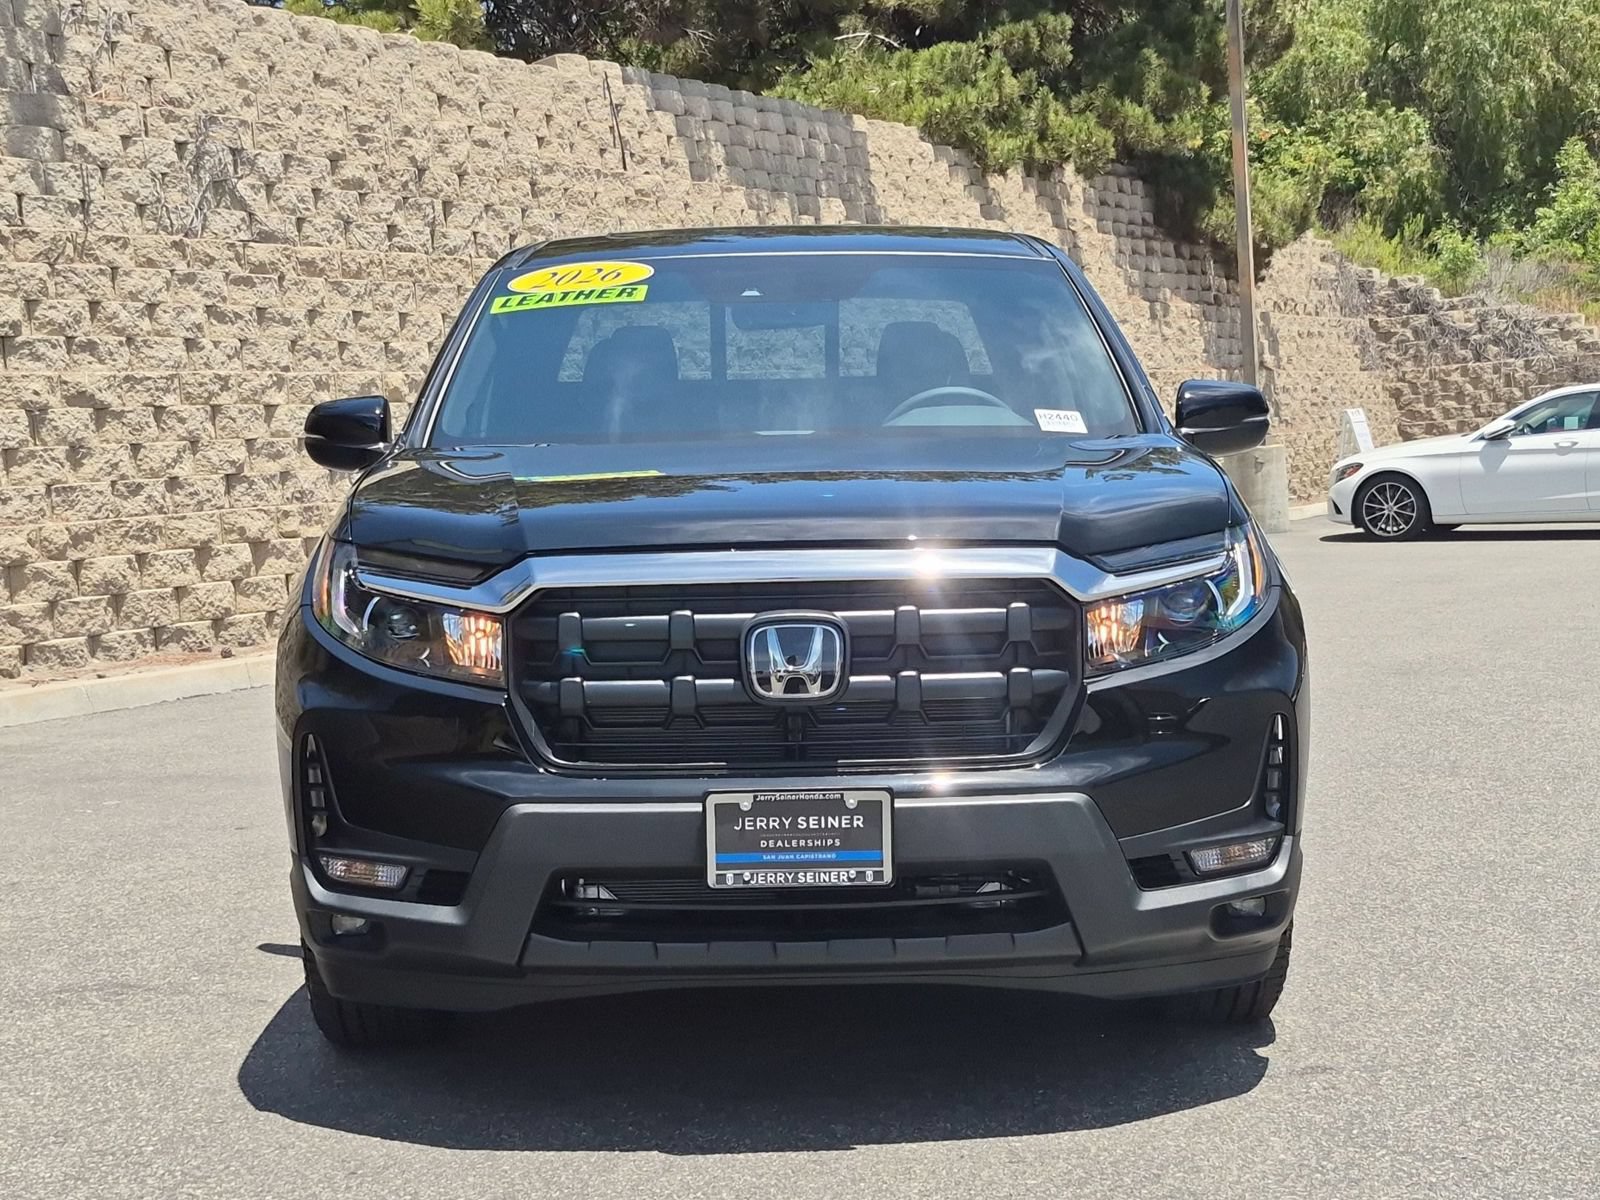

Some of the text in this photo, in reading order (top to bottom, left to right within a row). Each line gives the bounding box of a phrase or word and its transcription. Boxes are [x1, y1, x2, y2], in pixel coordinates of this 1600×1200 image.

[531, 267, 626, 288] 2026
[497, 287, 638, 309] LEATHER
[756, 793, 841, 802] JerrySeinerHonda.com
[734, 815, 864, 830] JERRY SEINER
[760, 838, 841, 848] DEALERSHIPS
[750, 871, 848, 884] JERRY SEINER
